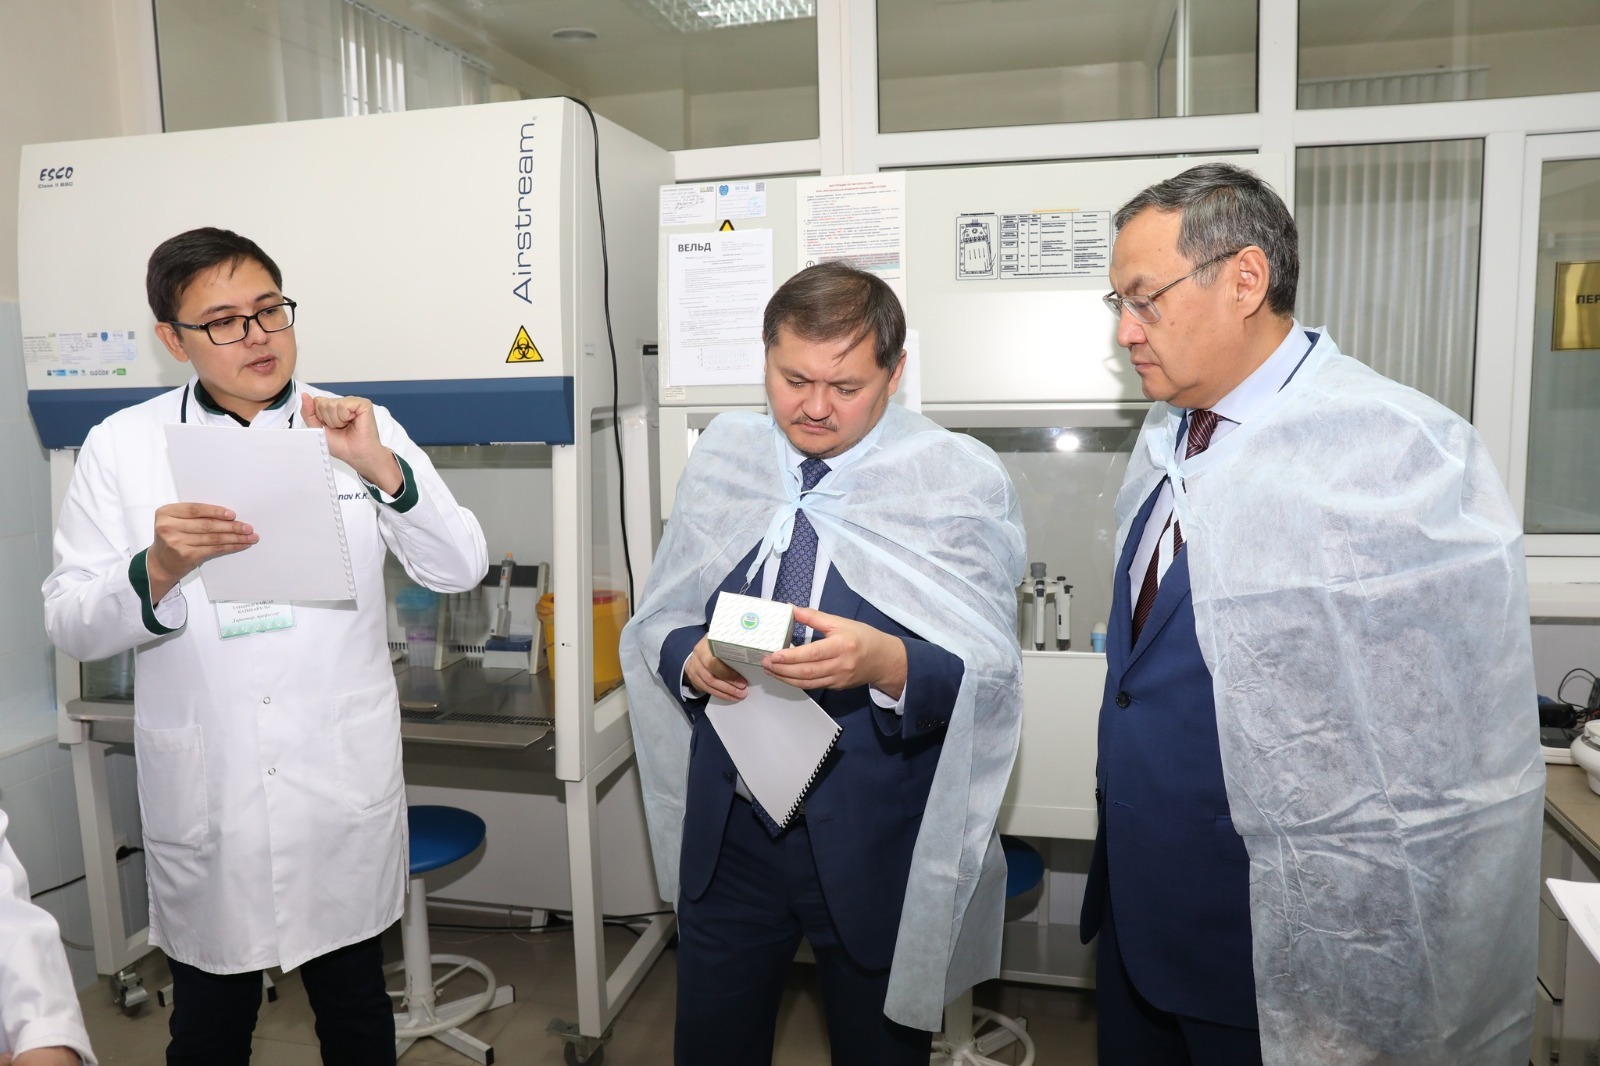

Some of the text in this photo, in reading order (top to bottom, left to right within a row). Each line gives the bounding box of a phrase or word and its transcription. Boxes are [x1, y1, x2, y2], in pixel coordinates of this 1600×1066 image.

[39, 166, 74, 181] ESCO
[512, 122, 535, 304] Airstream
[678, 242, 711, 253] ВЕЛЬД
[355, 492, 370, 500] K.K.
